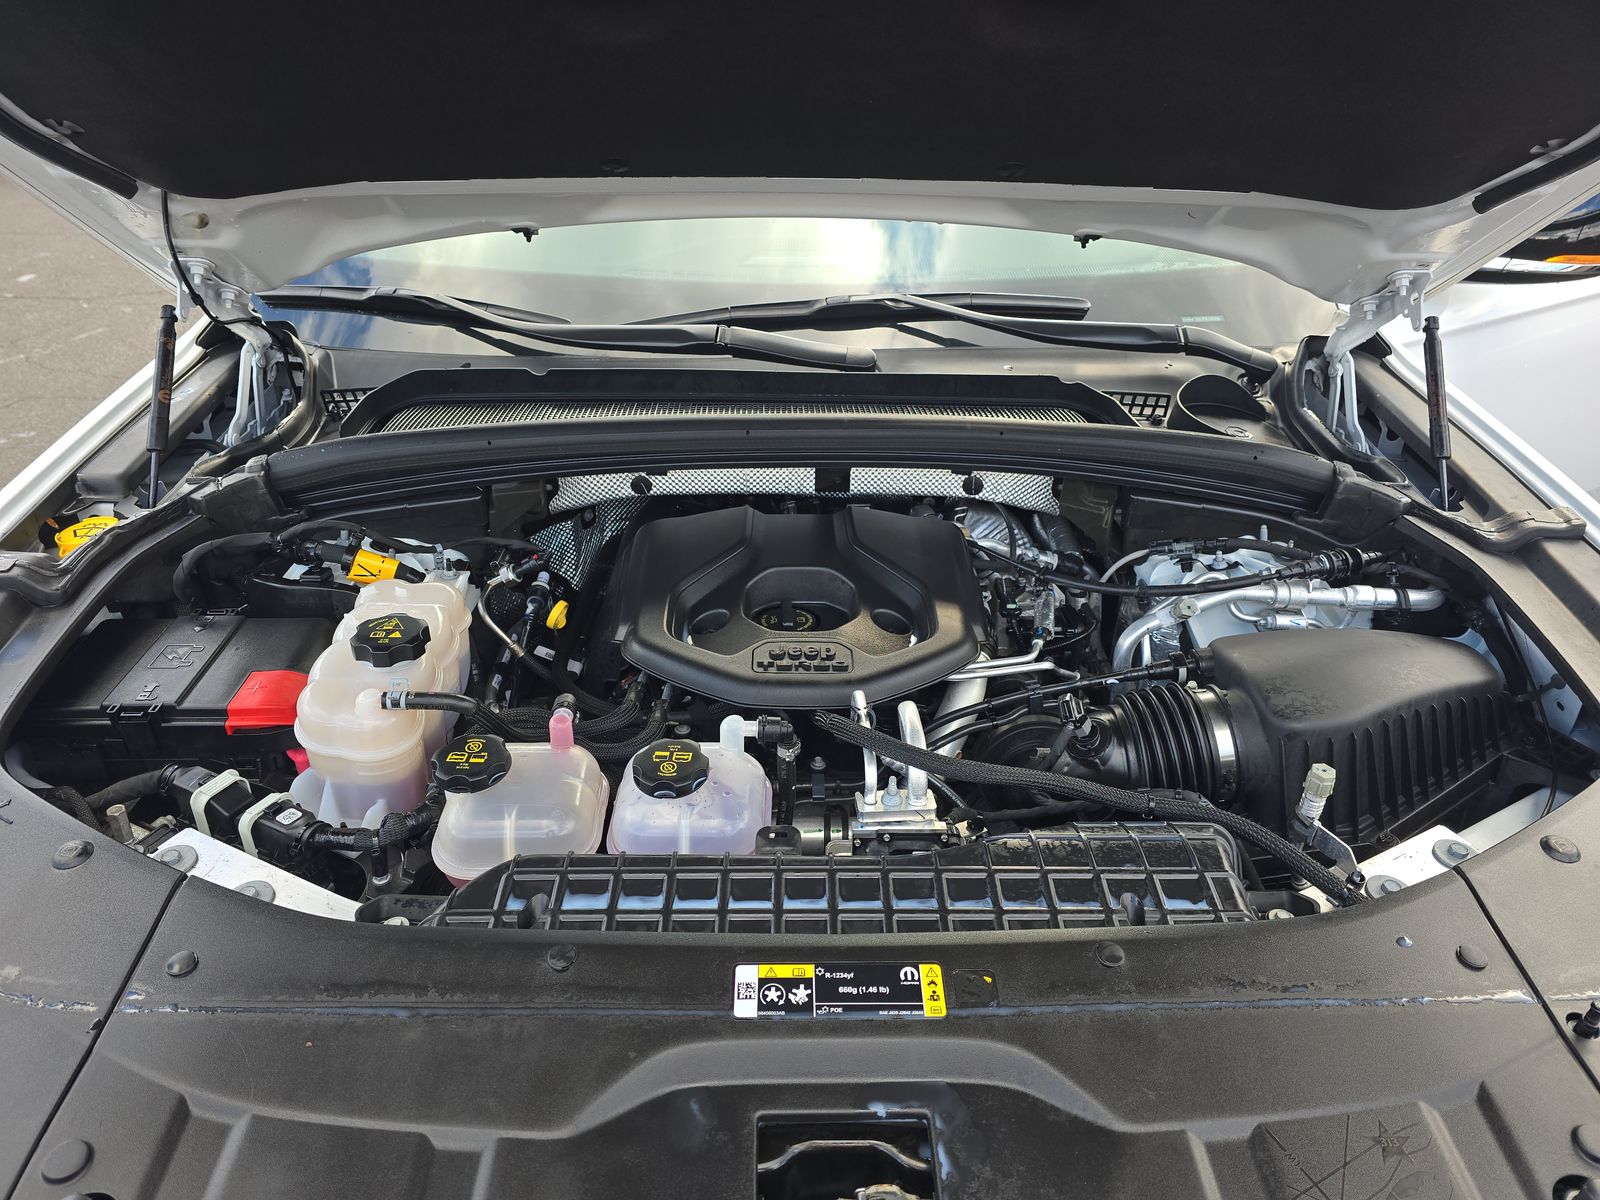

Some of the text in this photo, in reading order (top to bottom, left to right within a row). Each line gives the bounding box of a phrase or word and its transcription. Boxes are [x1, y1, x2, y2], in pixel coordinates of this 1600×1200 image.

[769, 643, 837, 661] Jeep
[825, 971, 855, 979] R-1234yf
[838, 985, 890, 996] 660g (1.46 lb)
[1378, 1136, 1401, 1148] 313
